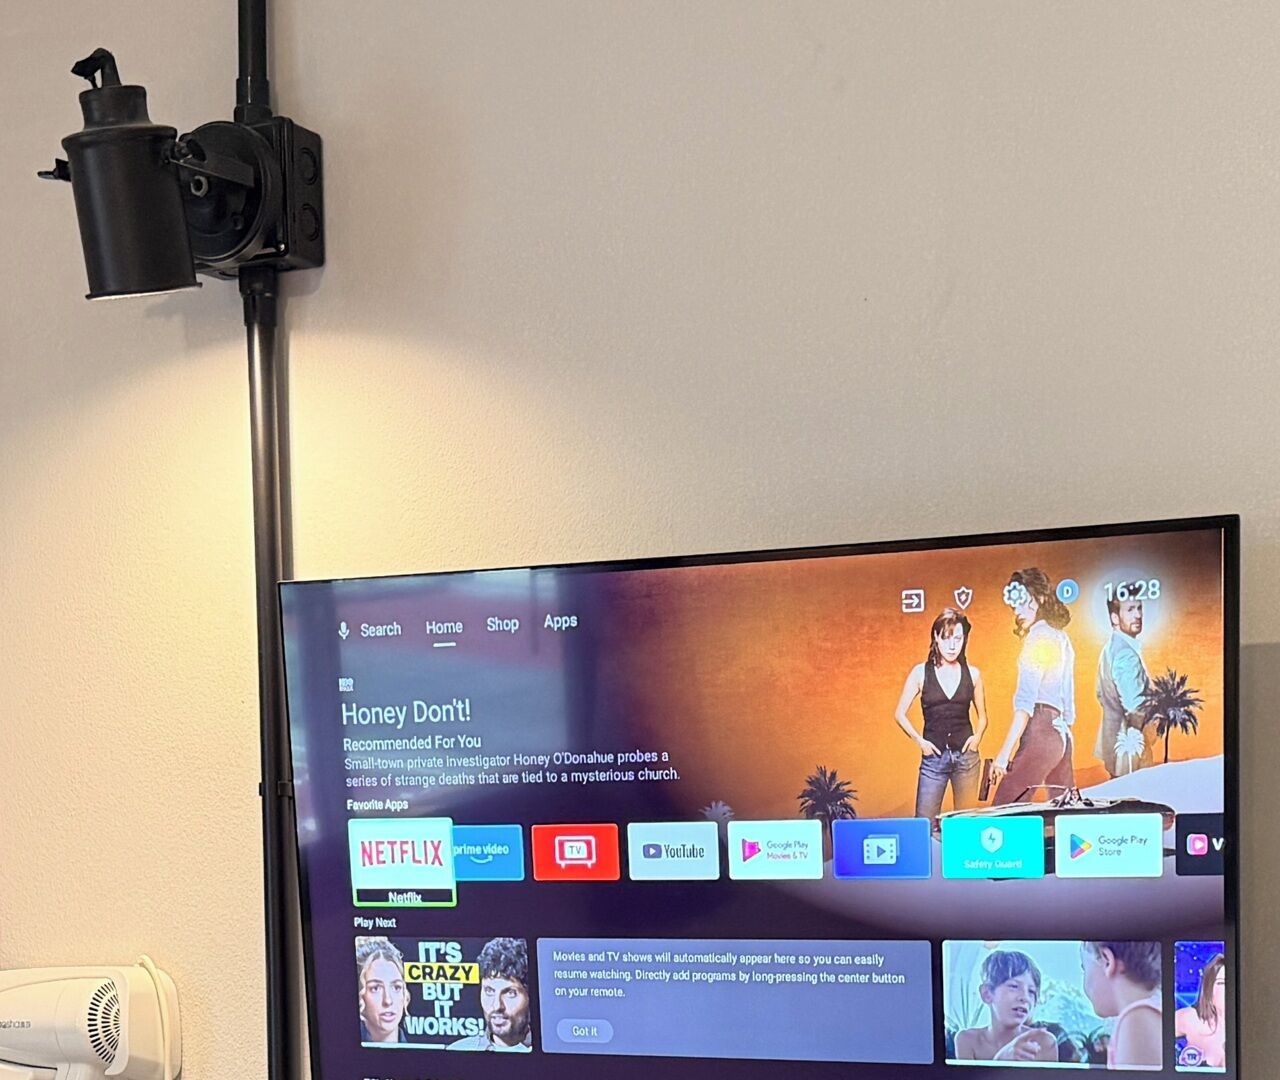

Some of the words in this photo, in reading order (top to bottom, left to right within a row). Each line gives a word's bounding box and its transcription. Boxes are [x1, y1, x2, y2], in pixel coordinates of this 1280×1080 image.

[1104, 579, 1161, 602] 16:28
[361, 621, 402, 638] Search
[426, 620, 464, 635] Home
[486, 617, 520, 633] Shop
[544, 613, 579, 631] Apps
[341, 701, 407, 729] Honey
[413, 698, 472, 724] Don't!
[343, 735, 432, 751] Recommended
[435, 736, 456, 749] For
[457, 735, 482, 748] You
[344, 756, 404, 770] Small-town
[407, 756, 444, 771] private
[446, 754, 511, 769] investigator
[513, 753, 551, 768] Honey
[553, 750, 614, 765] O'Donahue
[617, 749, 658, 765] probes
[661, 752, 669, 762] a
[346, 774, 378, 787] series
[380, 774, 392, 787] of
[395, 774, 436, 788] strange
[438, 771, 475, 786] deaths
[477, 771, 500, 784] that
[502, 773, 519, 784] are
[521, 770, 543, 783] tied
[546, 771, 558, 783] to
[561, 772, 568, 783] a
[571, 767, 635, 785] mysterious
[638, 767, 681, 781] church.
[346, 799, 384, 811] Favorite
[385, 799, 409, 812] Apps
[766, 840, 792, 851] Google
[793, 839, 809, 850] Play
[1098, 835, 1129, 847] Google
[1130, 835, 1149, 847] Play
[360, 839, 444, 867] NETFLIX
[453, 844, 482, 857] prime
[482, 843, 510, 856] video
[568, 845, 582, 855] TV
[663, 843, 705, 858] YouTube
[766, 851, 791, 860] Movies
[798, 850, 809, 860] TV
[1098, 846, 1122, 857] Store
[388, 891, 423, 904] Netflix
[353, 916, 374, 930] Play
[375, 916, 397, 928] Next
[417, 942, 463, 963] IT'S
[552, 951, 586, 962] Movies
[588, 951, 605, 962] and
[606, 951, 620, 962] TV
[622, 951, 653, 963] shows
[654, 952, 671, 963] will
[673, 952, 738, 966] automatically
[739, 954, 772, 966] appear
[774, 953, 796, 964] here
[798, 955, 811, 965] so
[813, 955, 832, 967] you
[833, 955, 852, 965] can
[854, 954, 885, 967] easily
[408, 964, 474, 981] CRAZY
[554, 970, 588, 980] resume
[589, 969, 633, 982] watching.
[635, 969, 671, 983] Directly
[672, 970, 690, 981] add
[692, 971, 736, 984] programs
[739, 971, 750, 984] by
[752, 972, 818, 985] long-pressing
[819, 972, 836, 983] the
[837, 972, 870, 983] center
[871, 973, 906, 984] button
[422, 983, 464, 1001] BUT
[554, 987, 567, 997] on
[568, 988, 588, 999] your
[590, 987, 626, 998] remote.
[434, 1000, 454, 1018] IT
[404, 1016, 486, 1037] WORKS!
[572, 1025, 589, 1037] Got
[591, 1026, 598, 1036] it
